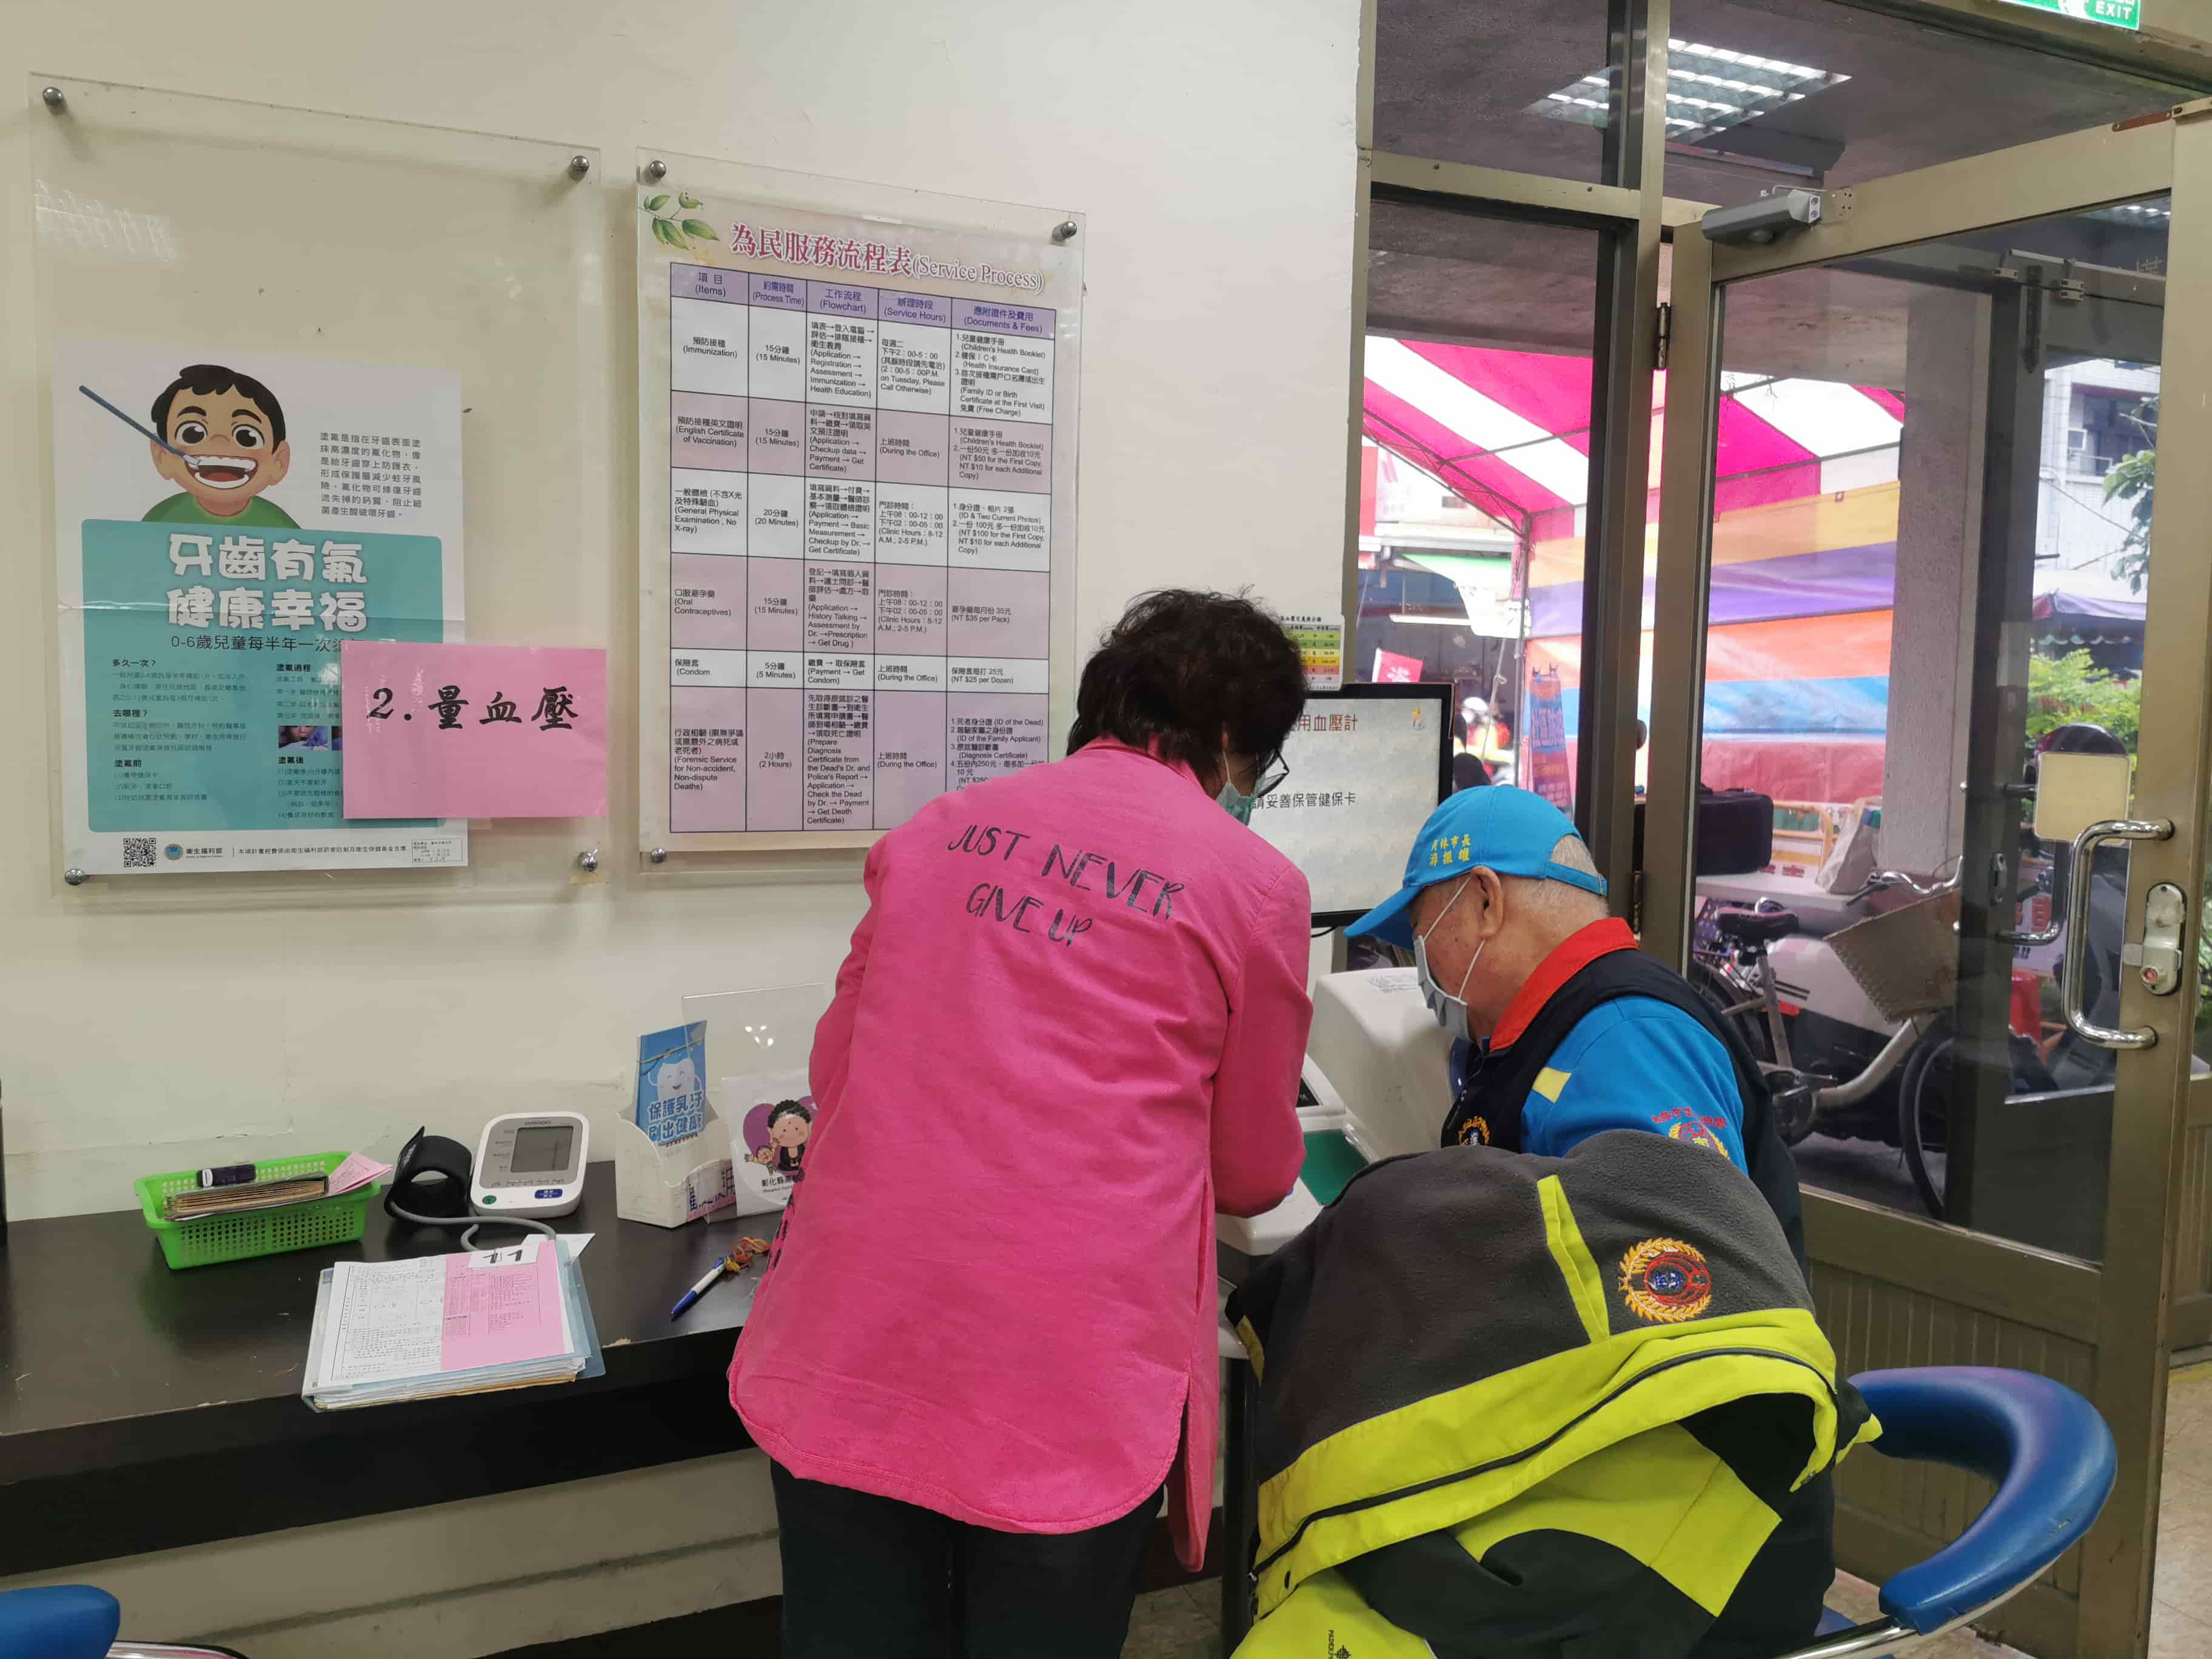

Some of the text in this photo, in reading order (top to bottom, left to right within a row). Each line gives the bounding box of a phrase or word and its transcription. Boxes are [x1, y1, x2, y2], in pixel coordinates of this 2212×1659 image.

[2096, 1, 2132, 20] EXIT
[913, 256, 1045, 295] (Service Process)
[695, 284, 726, 298] (Items)
[825, 288, 863, 302] 工作流程
[752, 292, 805, 307] (Process Time)
[820, 300, 866, 313] (Flowchart)
[884, 306, 946, 323] (Service Hours)
[964, 316, 1010, 330] (Documents
[1020, 322, 1042, 333] Fees)
[683, 344, 737, 359] (Immunization)
[810, 349, 851, 360] (Application
[961, 343, 1045, 359] (Children's Health Booklet)
[756, 353, 800, 365] (15 Minutes)
[810, 358, 851, 369] Registration
[810, 367, 853, 378] Assessment
[963, 360, 1039, 376] (Health Insurance Card)
[810, 377, 856, 387] Immunization
[922, 377, 945, 387] Please
[810, 386, 871, 398] Health Education)
[880, 383, 931, 395] Call Otherwise)
[1003, 390, 1017, 399] Birth
[960, 395, 990, 405] Certificate
[976, 405, 1021, 417] (Free Charge)
[675, 426, 743, 438] (English Certificate
[692, 436, 737, 447] Vaccination)
[756, 437, 799, 447] (15 Minutes)
[809, 436, 850, 446] (Application
[960, 436, 1044, 451] (Children's Health Booklet)
[809, 444, 840, 455] Checkup
[879, 447, 940, 458] (During Office)
[809, 454, 840, 464] Payment
[809, 463, 846, 473] Certificate)
[1012, 466, 1042, 476] Additional
[959, 471, 979, 481] Copy)
[674, 506, 739, 518] (General Physical
[809, 511, 849, 520] (Application
[674, 515, 720, 525] Examination
[754, 518, 799, 528] (20 Minutes)
[809, 520, 839, 529] Payment
[674, 525, 697, 534] X-ray)
[808, 529, 856, 538] Measurement
[808, 537, 840, 547] Checkup
[823, 546, 860, 557] Certificate)
[170, 533, 367, 583] 牙齒有氟
[674, 597, 693, 606] (Oral
[167, 585, 367, 632] 健康幸福
[674, 606, 731, 617] Contraceptives)
[754, 606, 798, 616] (15 Minutes)
[808, 603, 849, 612] (Application
[808, 612, 858, 623] History Talking
[991, 615, 1010, 624] Pack)
[808, 622, 850, 630] Assessment
[828, 631, 868, 640] Prescription
[172, 634, 343, 652] 0-6歲兒童每半年一次塗
[677, 668, 710, 677] (Condom
[756, 671, 796, 680] (5 Minutes)
[808, 668, 841, 677] (Payment
[808, 677, 840, 685] Condom)
[877, 674, 902, 683] (During
[1292, 713, 1358, 732] 用血壓計
[808, 738, 837, 747] (Prepare
[959, 751, 992, 760] (Diagnosis
[877, 760, 902, 769] (During
[674, 774, 718, 783] Non-dispute
[948, 825, 1185, 919] JUST NEVER
[966, 883, 1093, 948] GIVE UP
